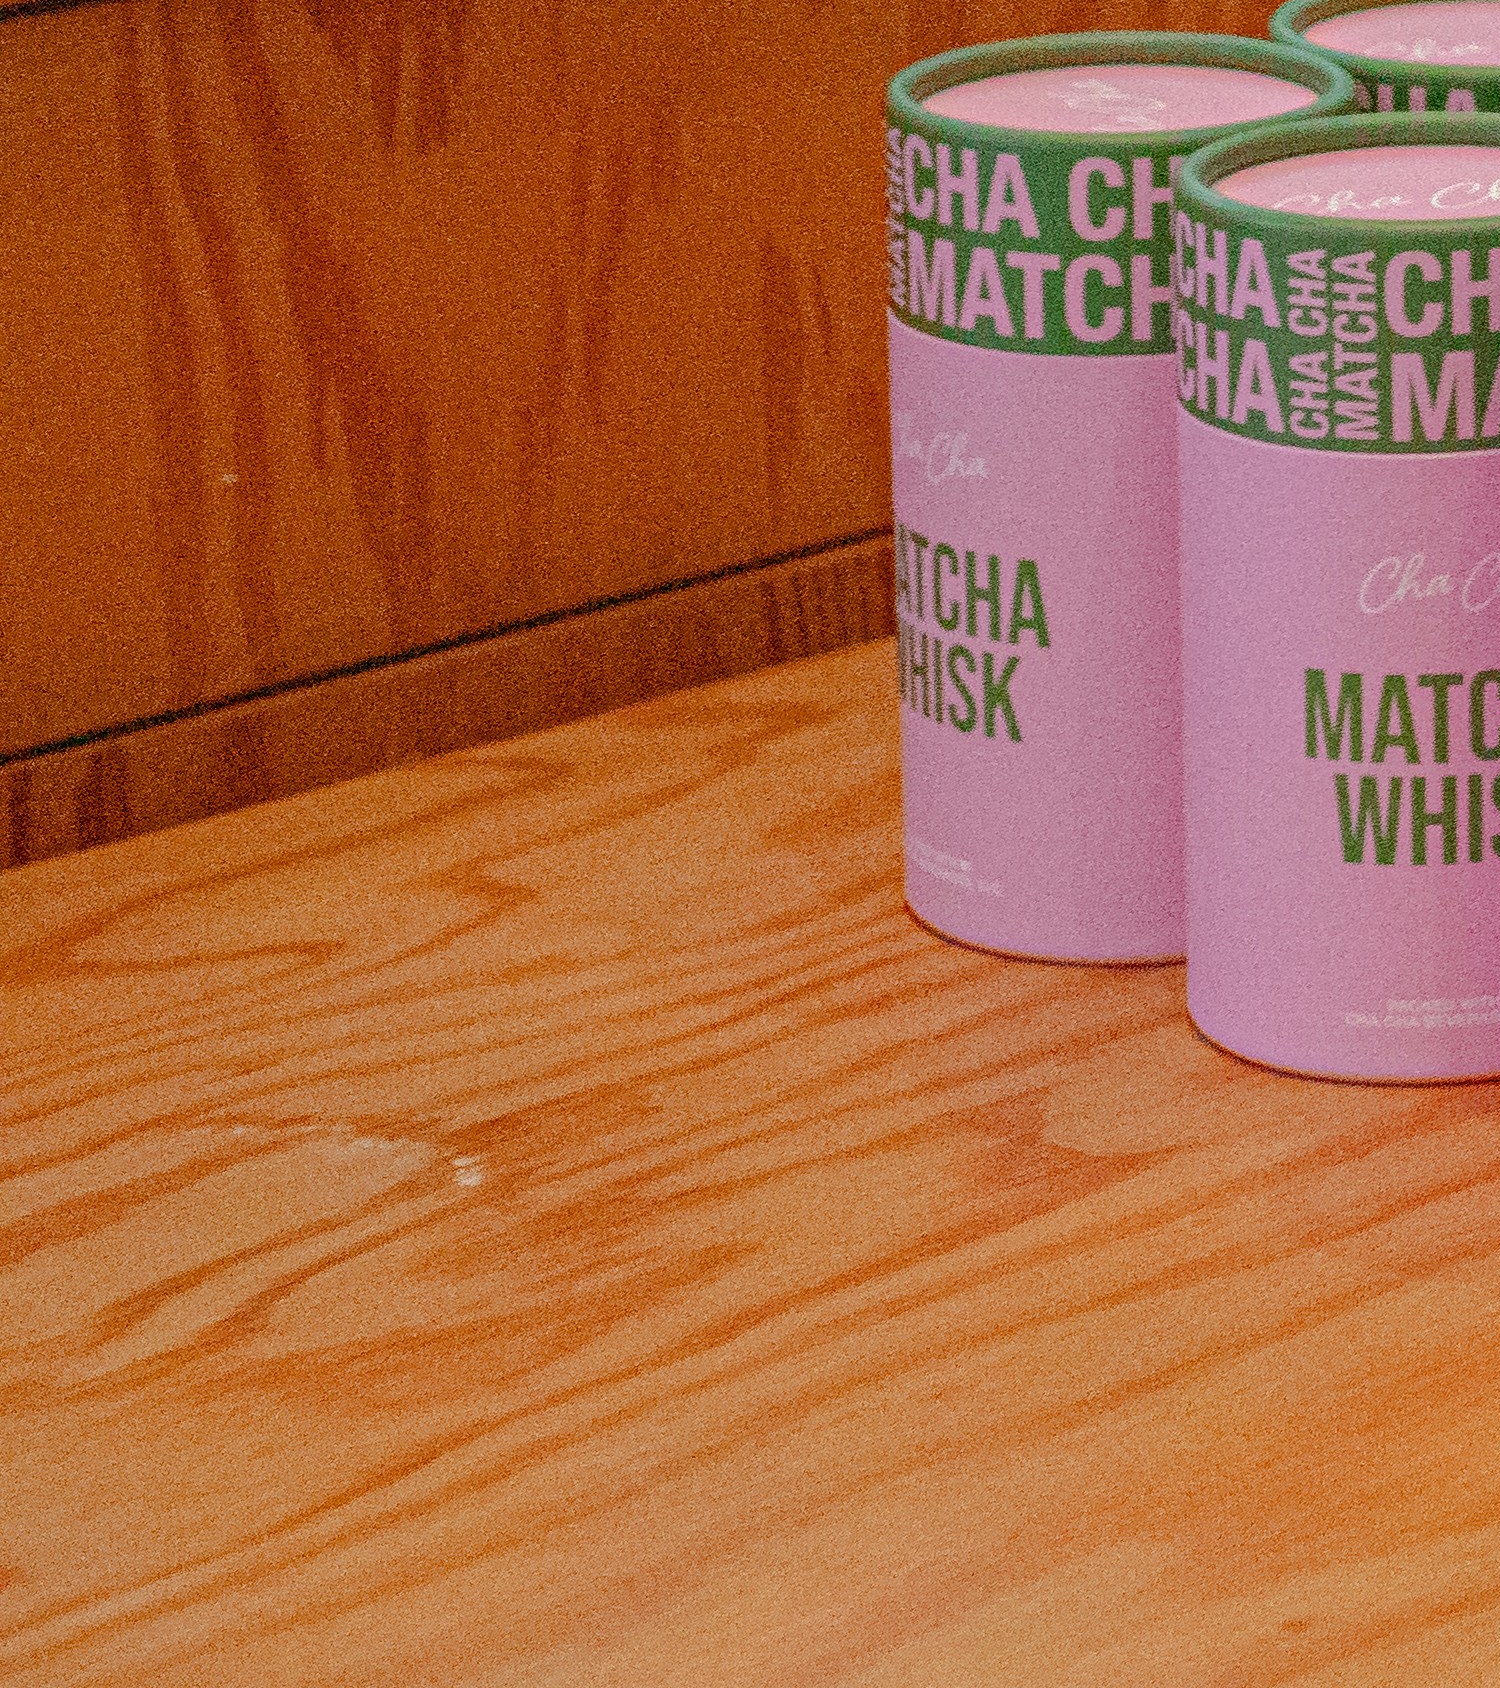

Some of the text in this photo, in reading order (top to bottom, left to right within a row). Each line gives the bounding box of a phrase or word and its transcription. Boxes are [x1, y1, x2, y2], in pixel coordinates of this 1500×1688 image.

[900, 132, 1042, 240] CHA
[1173, 209, 1281, 328] CHA
[1175, 308, 1286, 435] CHA
[1286, 248, 1331, 440] CHA CHA
[1330, 249, 1380, 442] MATCHA
[1358, 551, 1453, 616] Cha
